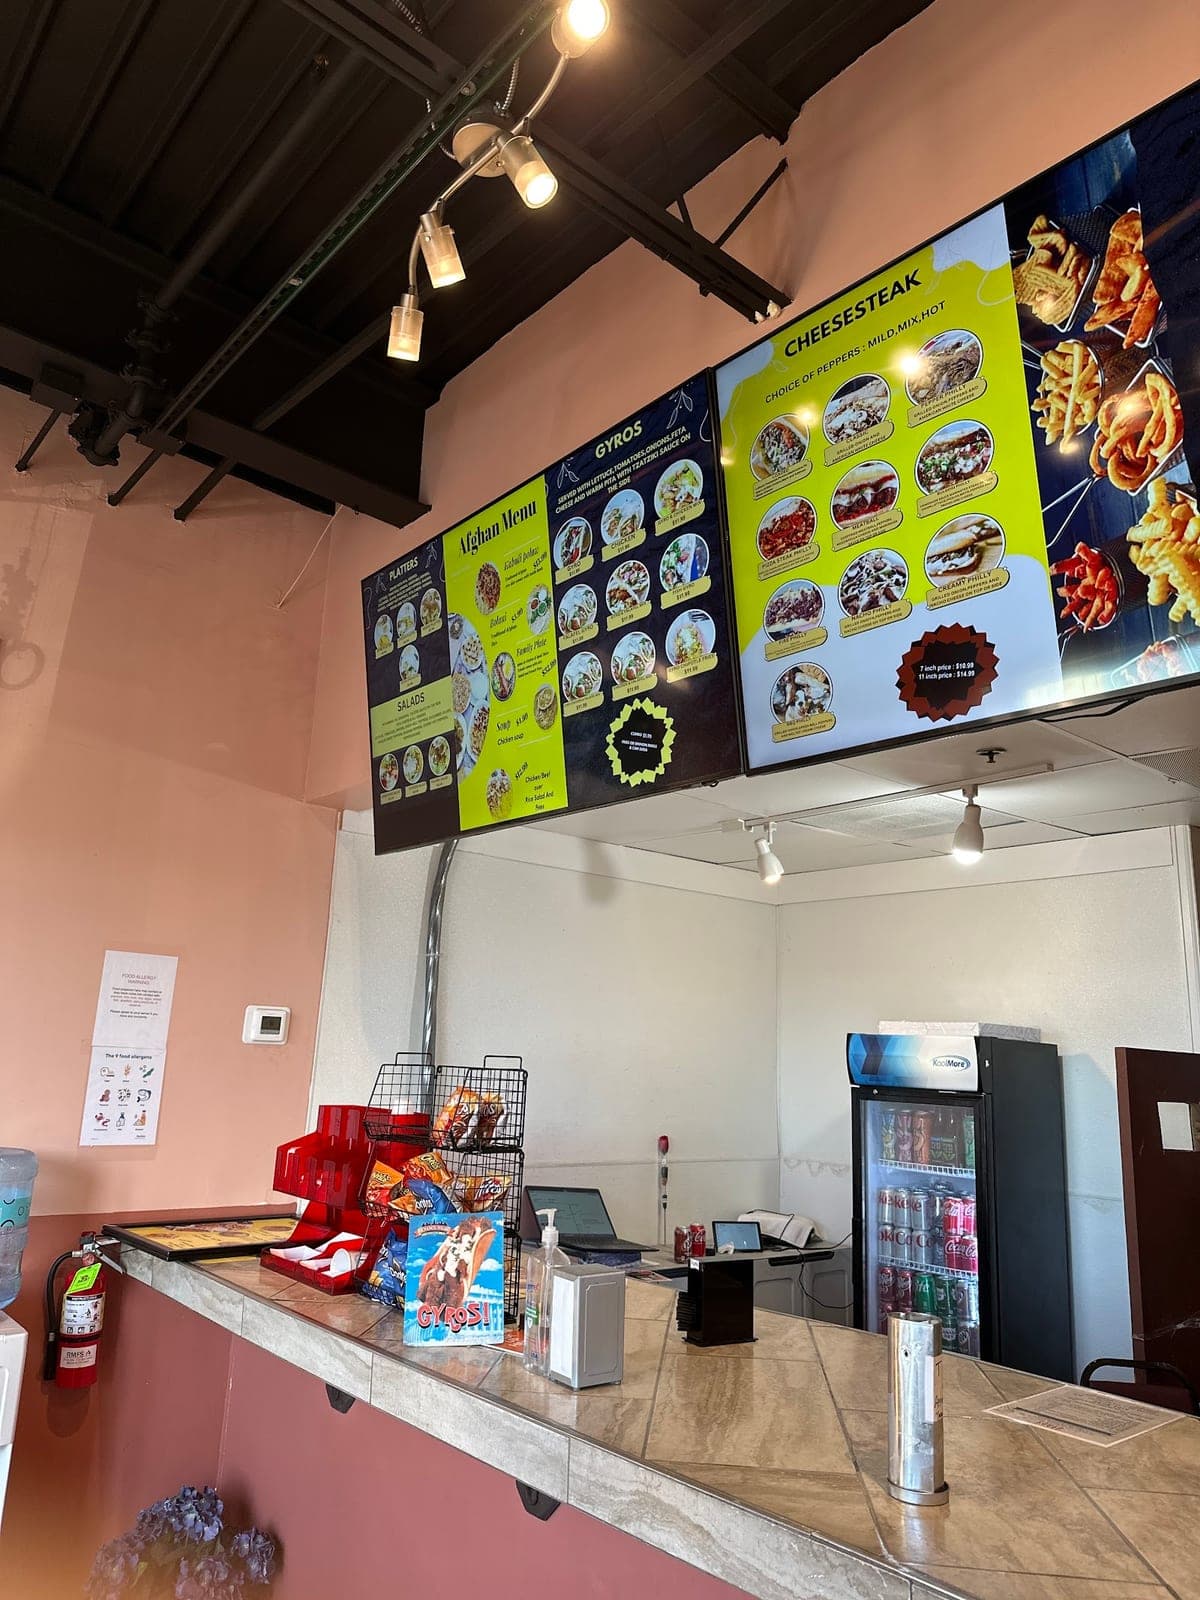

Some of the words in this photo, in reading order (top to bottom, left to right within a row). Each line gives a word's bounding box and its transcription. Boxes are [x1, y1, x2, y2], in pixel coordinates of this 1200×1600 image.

[784, 269, 922, 357] CHEESESTEAK
[765, 379, 800, 404] CHOICE
[802, 370, 816, 384] OF
[818, 347, 860, 376] PEPPERS
[868, 300, 946, 348] MILD,MIX,HOT
[945, 384, 966, 397] PHILLY
[594, 420, 643, 458] GYROS
[555, 500, 574, 514] CHEESE
[574, 494, 586, 506] AND
[586, 485, 604, 500] WARM
[604, 478, 616, 492] PITA
[616, 469, 632, 484] WITH
[660, 442, 680, 458] SAUCE
[680, 432, 691, 444] ON
[558, 489, 576, 504] SERVED
[576, 482, 591, 496] WITH
[607, 484, 618, 495] THE
[618, 476, 632, 490] SIDE
[460, 522, 500, 556] Afghan
[501, 501, 536, 532] Menu
[610, 534, 636, 550] CHICKEN
[567, 561, 582, 572] GYRO
[776, 552, 792, 562] STEAK
[390, 556, 418, 582] PLATTERS
[938, 577, 965, 592] CREAMY
[967, 572, 990, 582] PHILLY
[398, 692, 424, 712] SALADS
[498, 736, 514, 746] Chicken
[514, 733, 524, 742] soup
[534, 794, 546, 802] Salad
[546, 791, 554, 799] And
[932, 1060, 965, 1068] KoolMore
[418, 1301, 490, 1333] GYROS!
